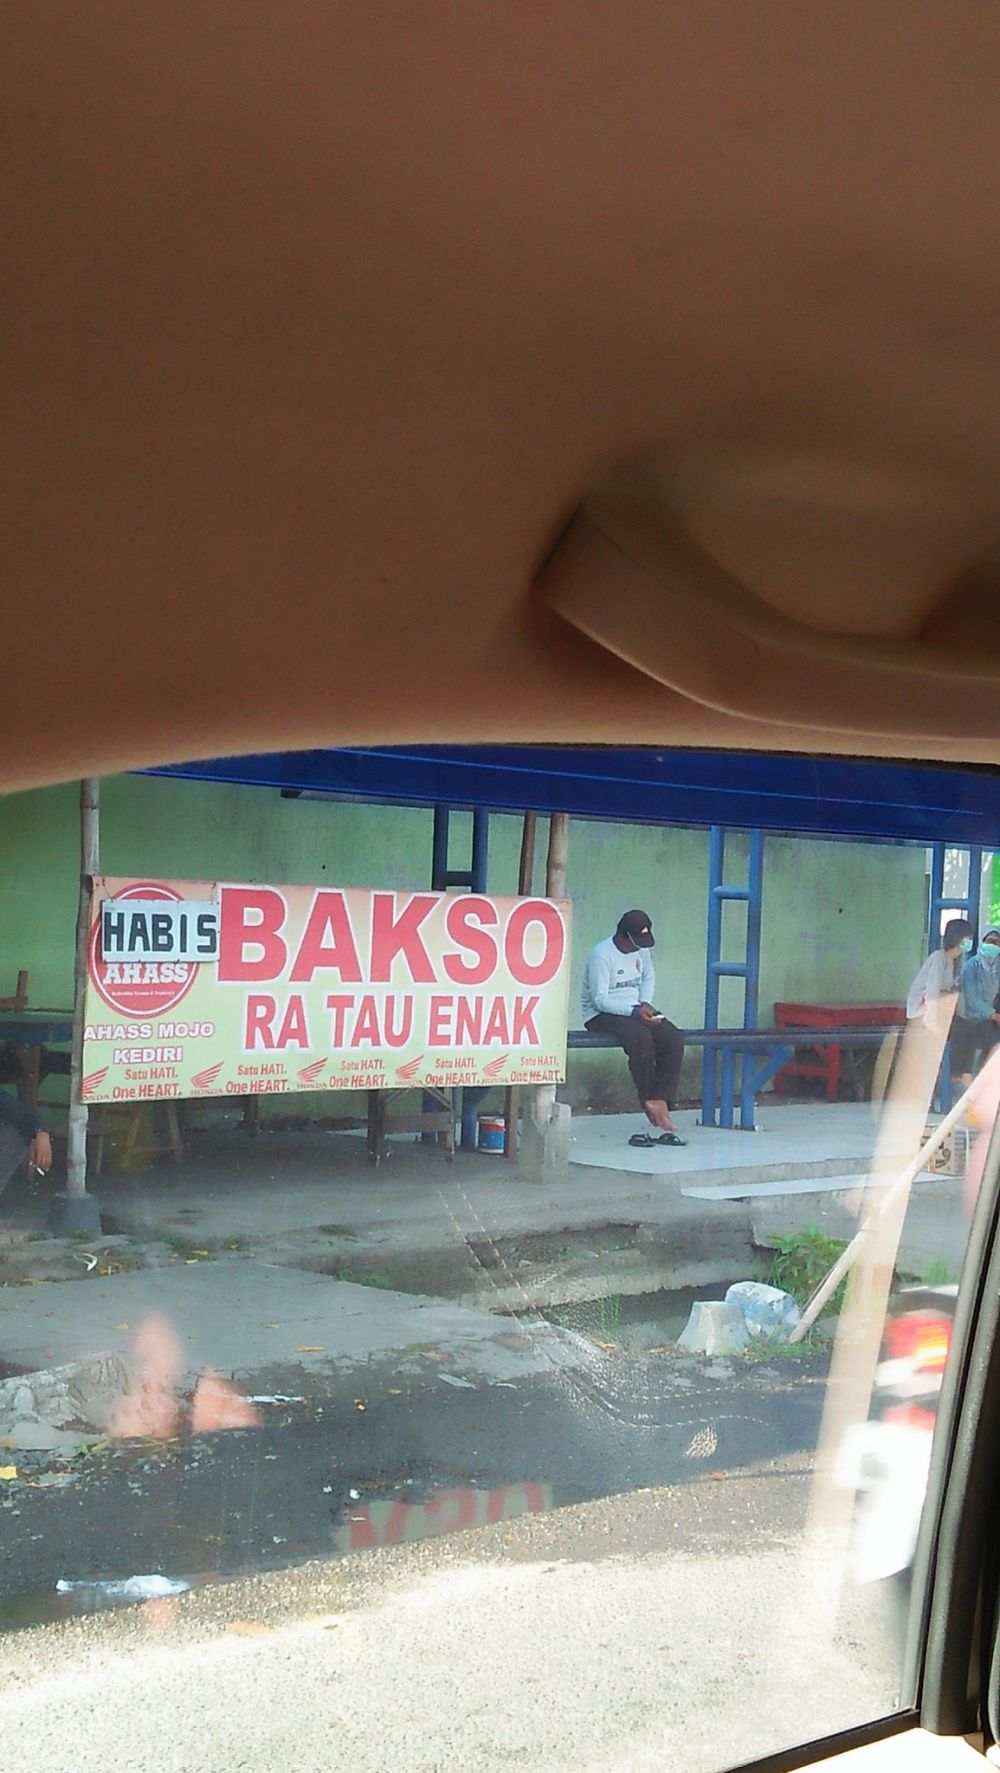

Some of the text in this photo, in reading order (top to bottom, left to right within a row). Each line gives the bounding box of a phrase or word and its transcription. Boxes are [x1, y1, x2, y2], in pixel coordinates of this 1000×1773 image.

[104, 911, 217, 953] HABIS
[217, 886, 566, 987] BAKSO
[103, 963, 189, 984] AHASS
[245, 994, 541, 1050] RA TAU ENAK
[84, 1022, 215, 1040] AHASS MOJO
[113, 1047, 184, 1064] KEDIRI
[340, 1060, 359, 1071] Satu
[435, 1058, 452, 1068] Satu
[124, 1068, 148, 1080] Satu
[237, 1065, 258, 1076] Satu
[329, 1075, 349, 1088] One
[425, 1073, 444, 1084] One
[112, 1086, 136, 1099] One
[225, 1081, 248, 1093] One
